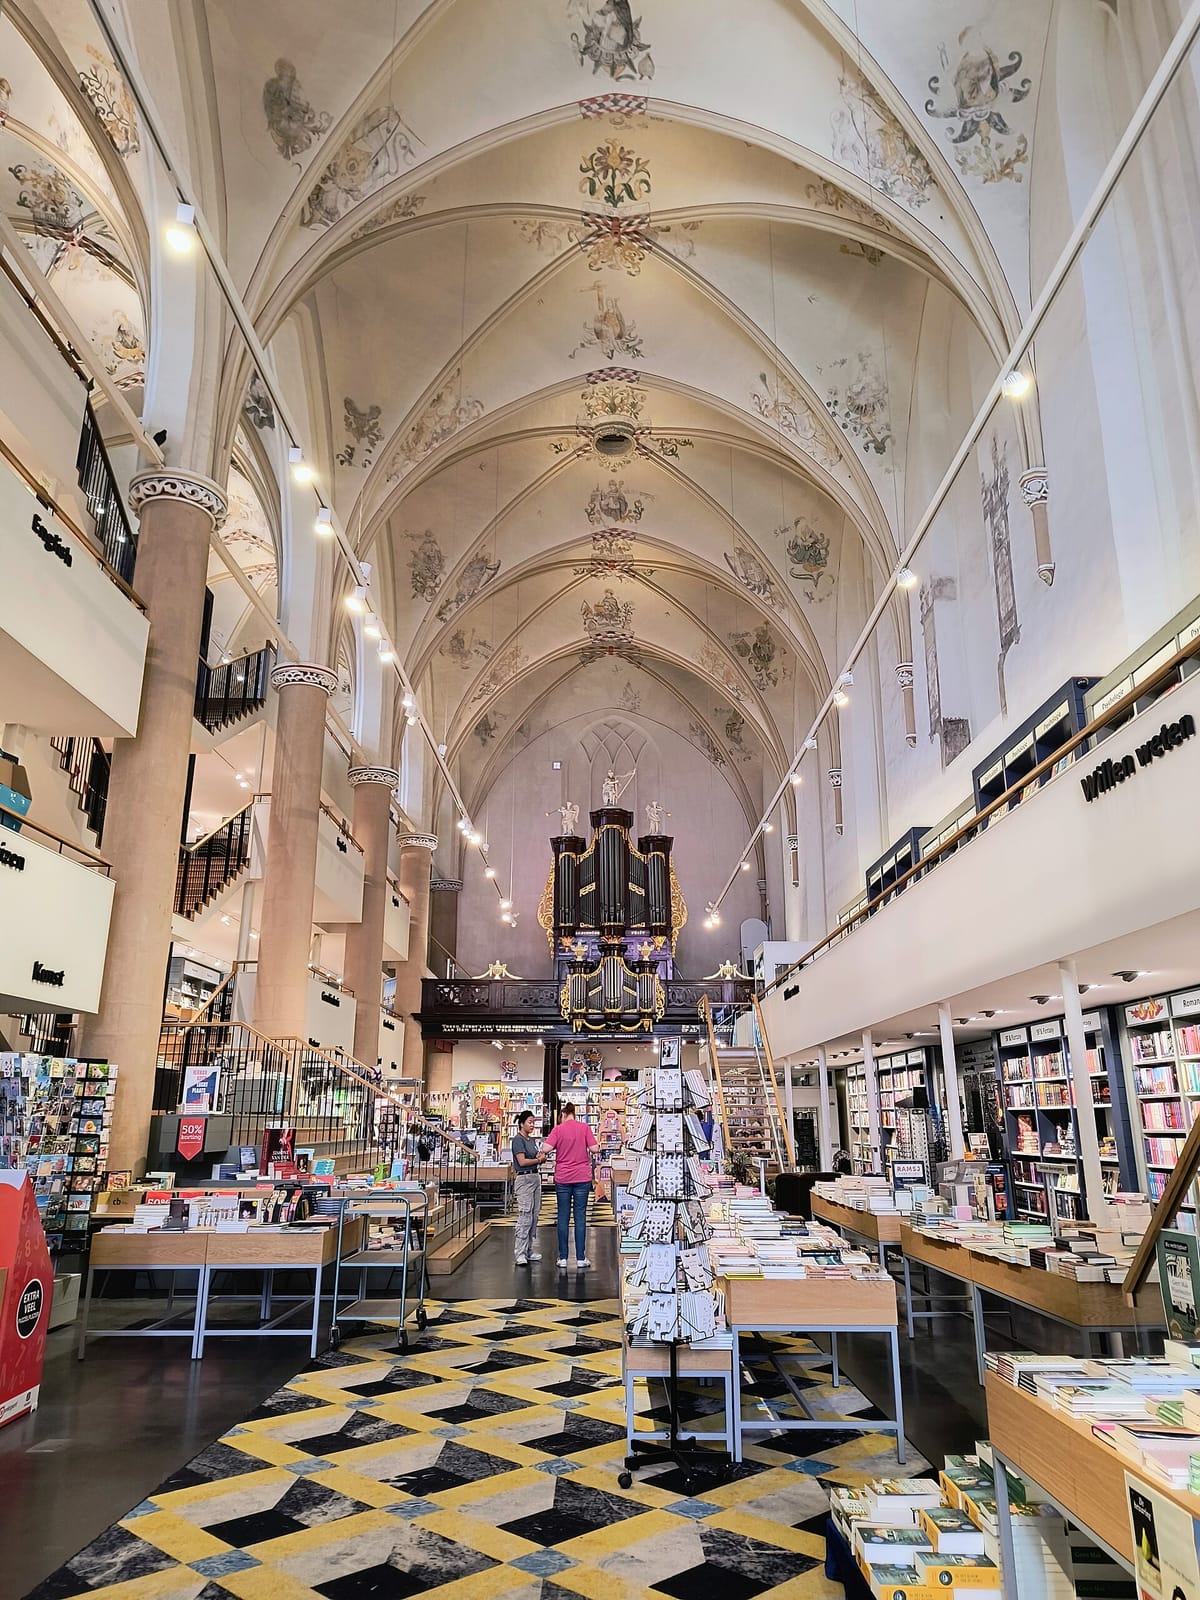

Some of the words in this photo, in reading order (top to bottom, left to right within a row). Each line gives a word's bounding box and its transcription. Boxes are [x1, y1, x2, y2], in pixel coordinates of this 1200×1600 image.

[1080, 753, 1136, 803] Willen
[1135, 714, 1196, 767] weten
[32, 960, 65, 987] Kunst
[182, 1125, 202, 1134] 50%
[23, 1289, 40, 1304] EXTRA
[24, 1301, 36, 1314] VEEL
